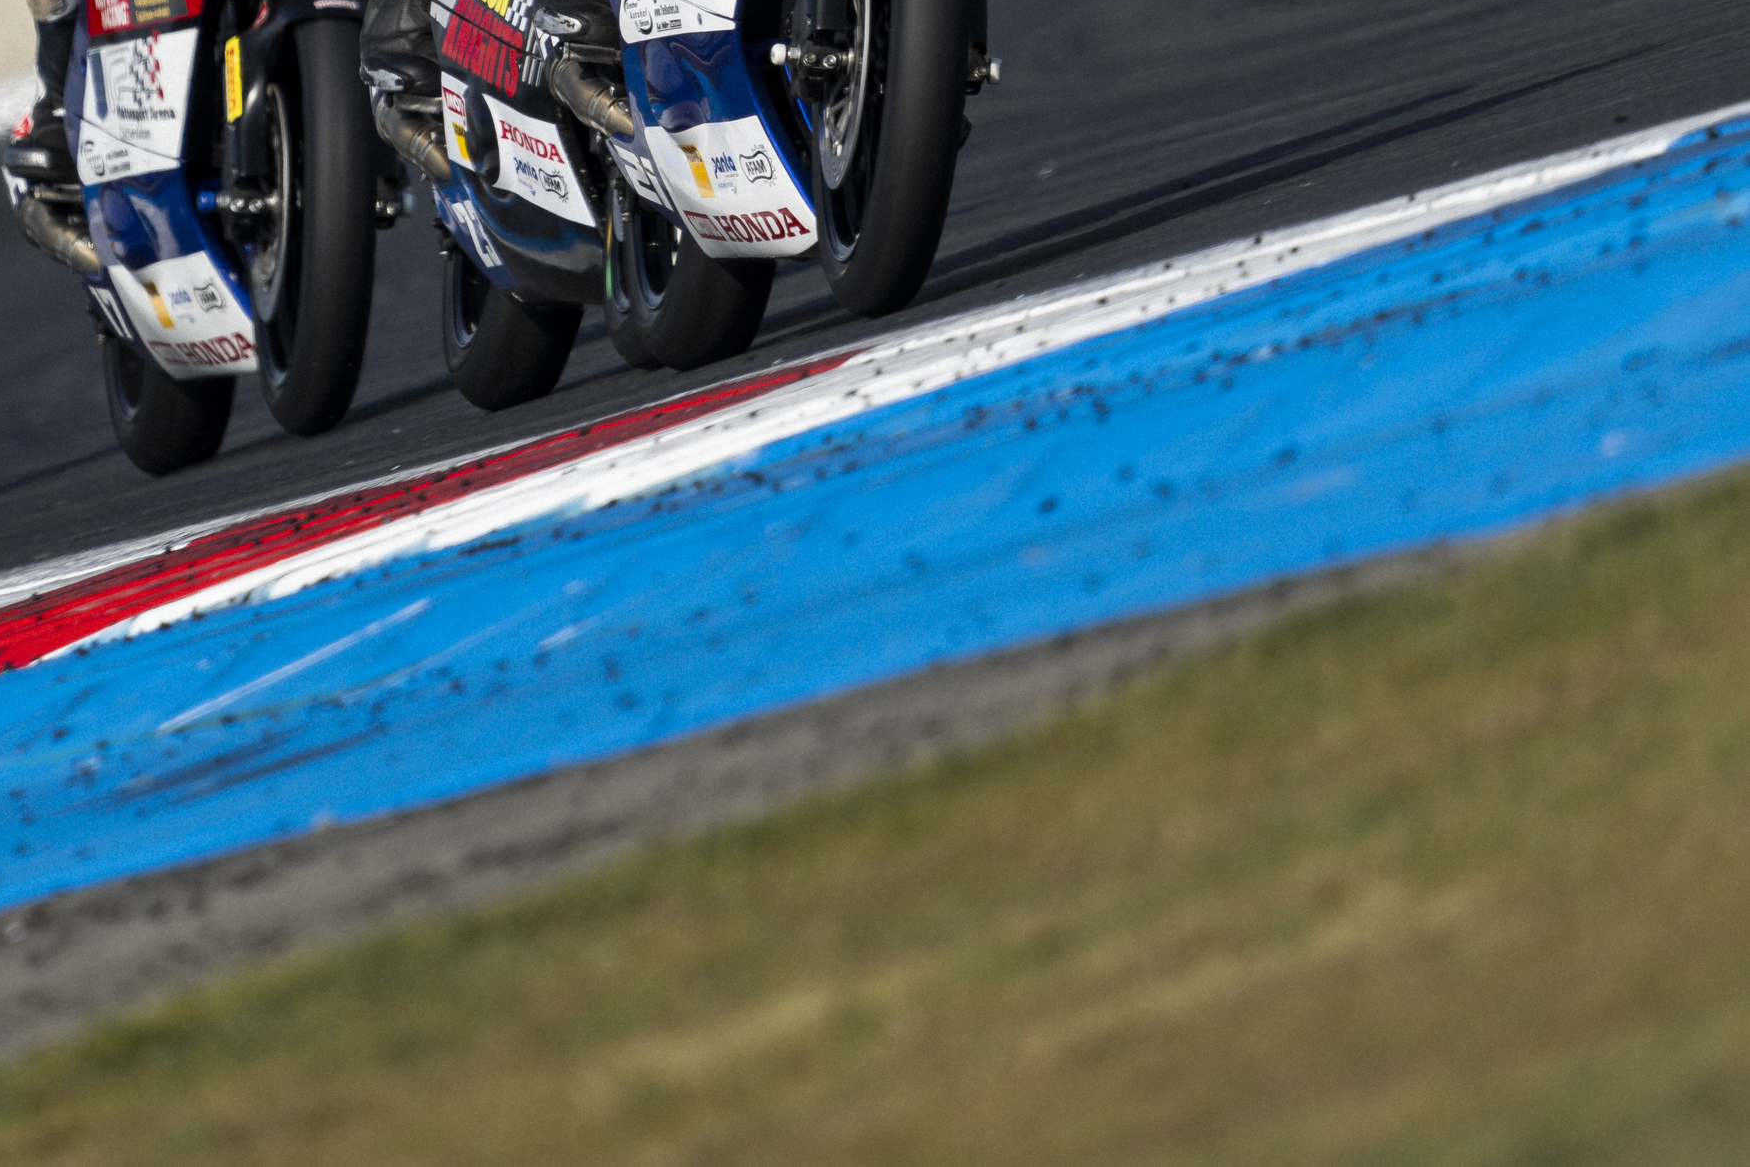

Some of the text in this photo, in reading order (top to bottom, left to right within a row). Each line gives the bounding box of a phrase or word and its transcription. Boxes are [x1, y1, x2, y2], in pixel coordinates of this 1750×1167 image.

[499, 120, 565, 165] HONDA
[745, 159, 768, 176] AFAM
[714, 207, 811, 243] HONDA
[175, 332, 256, 366] HONDA
